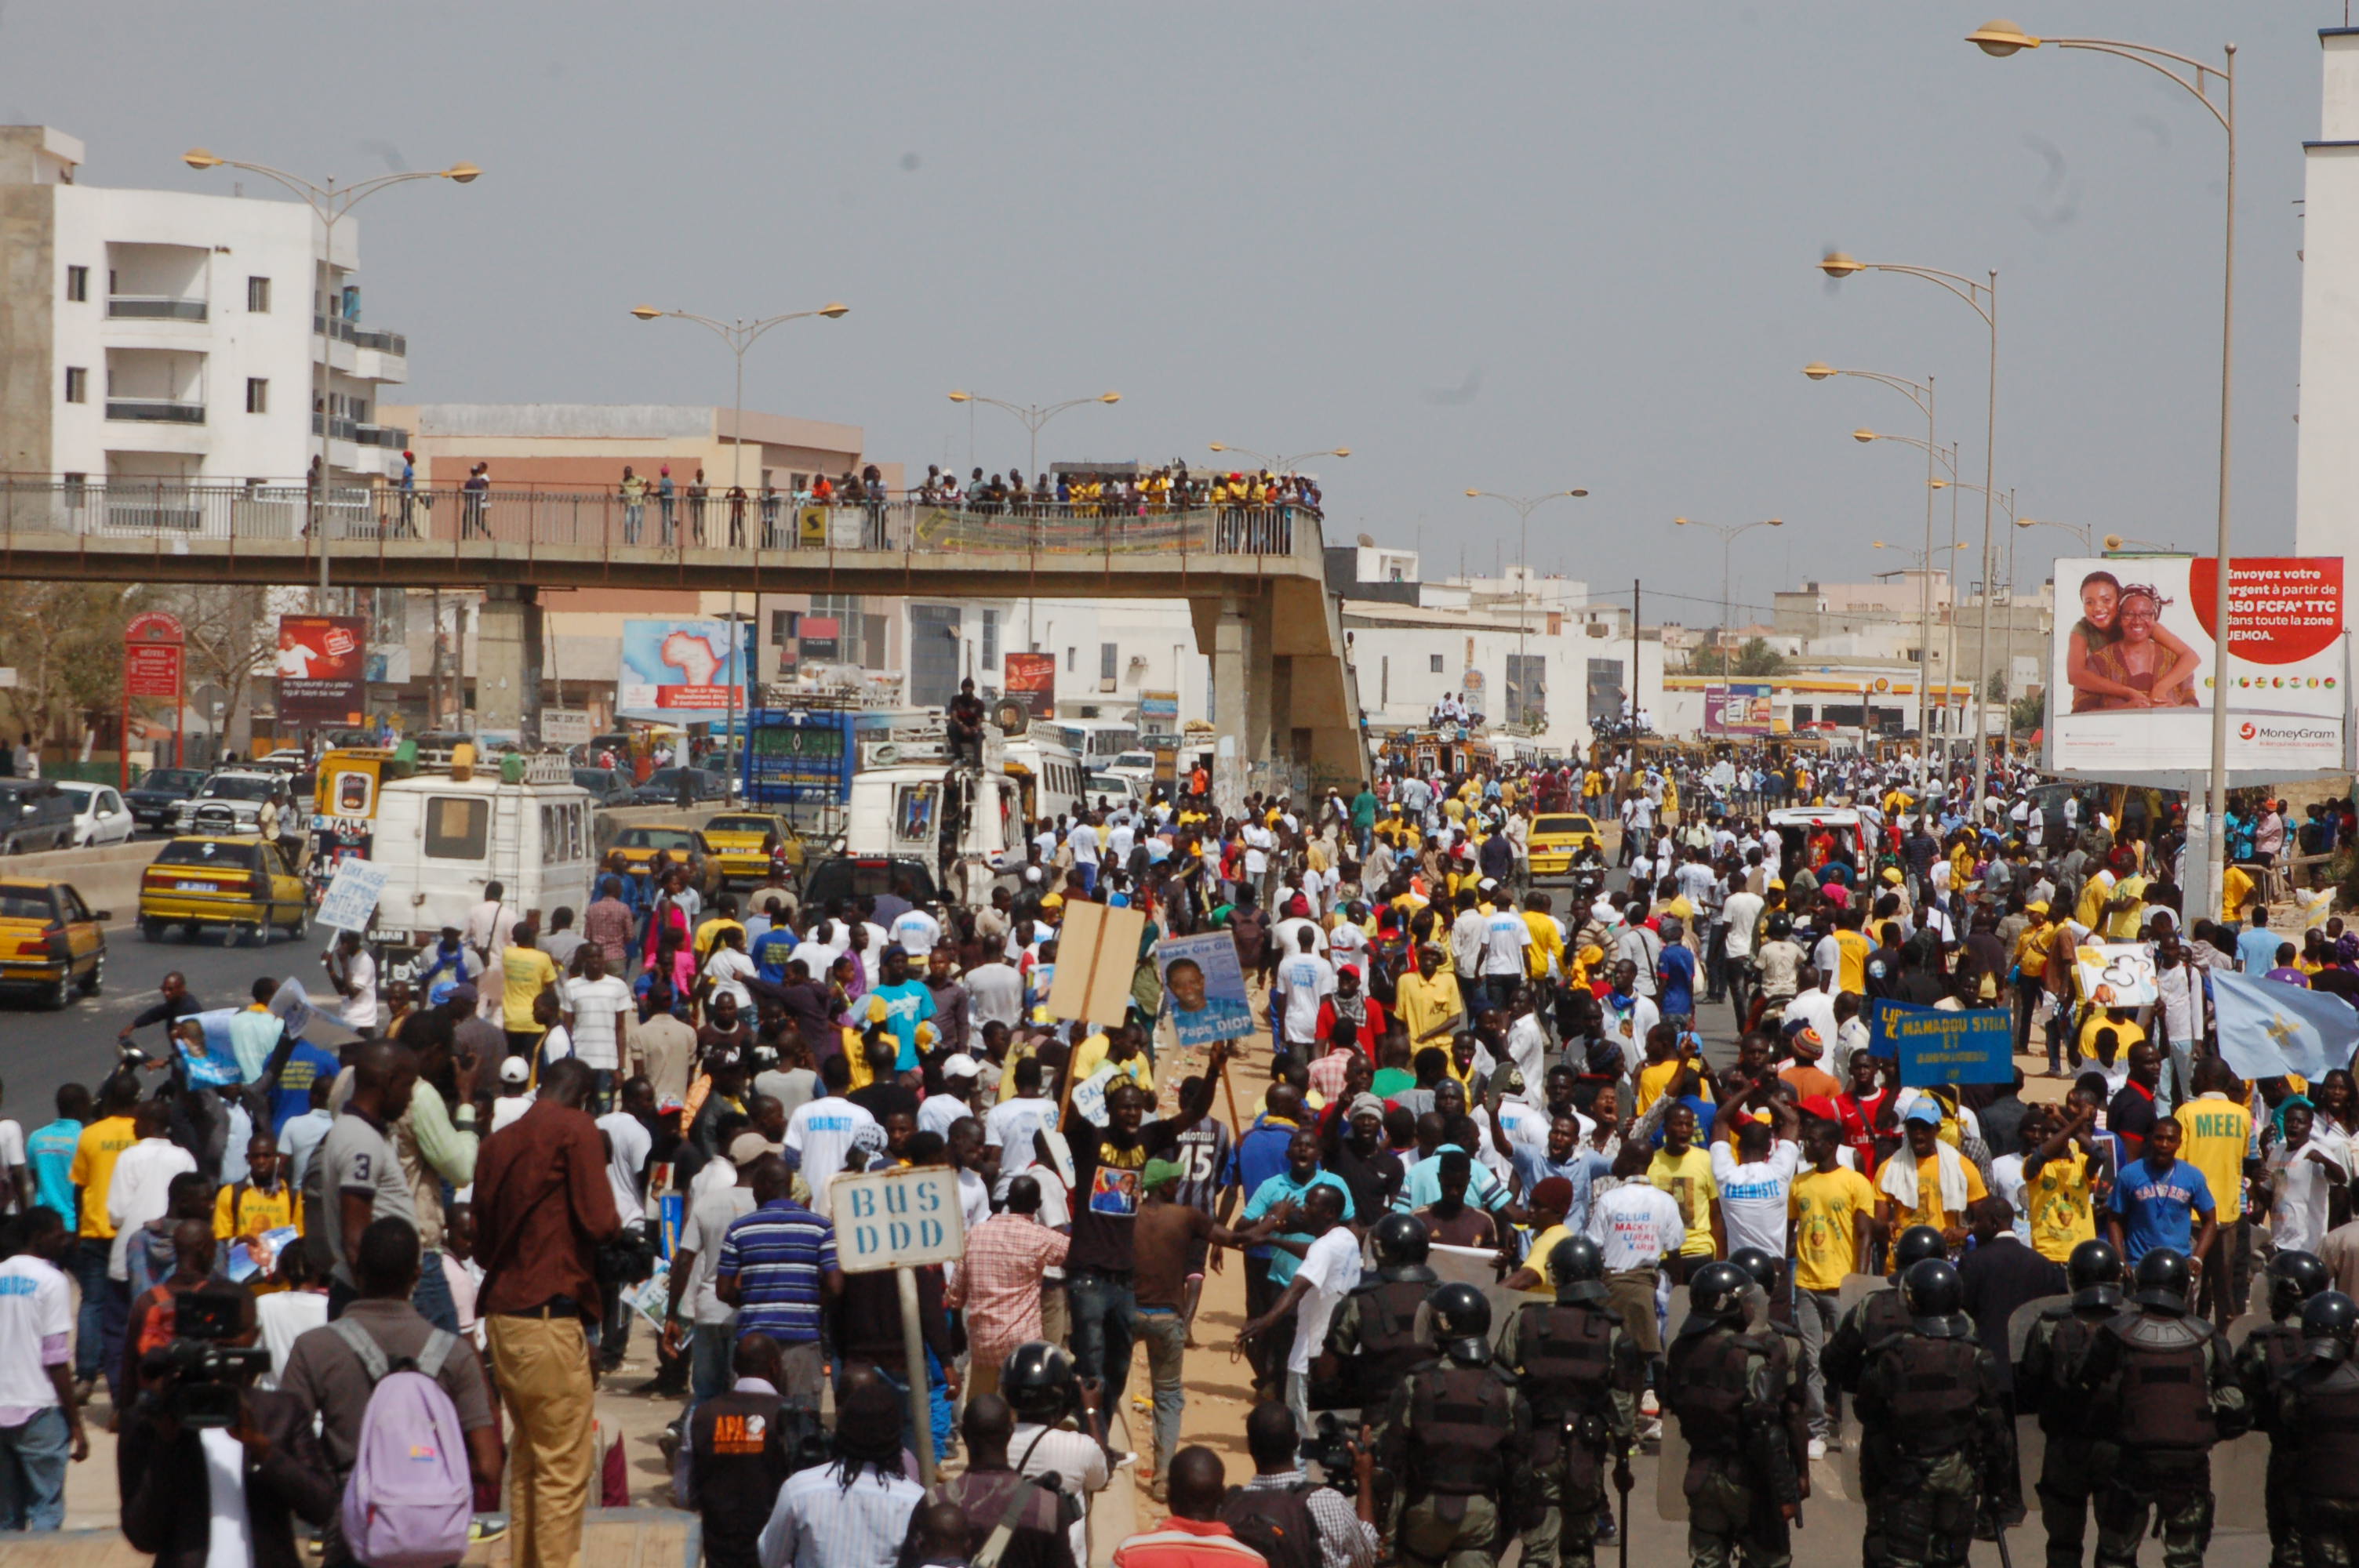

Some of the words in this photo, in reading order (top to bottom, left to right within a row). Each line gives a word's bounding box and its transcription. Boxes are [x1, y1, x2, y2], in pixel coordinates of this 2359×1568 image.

[2227, 570, 2281, 581] Envoyez
[2284, 569, 2321, 579] votre
[2272, 583, 2280, 594] à
[2282, 584, 2318, 596] partir
[2321, 583, 2337, 594] de
[2305, 601, 2336, 612] TTC
[2255, 616, 2288, 625] toute
[2291, 615, 2301, 625] la
[2303, 616, 2334, 625] zone
[2259, 728, 2335, 741] MoneyGram
[1177, 1025, 1212, 1039] Pape
[1216, 1015, 1251, 1032] DIOP
[1903, 1018, 1968, 1036] MAMADOU
[355, 1152, 370, 1181] 3
[1178, 1145, 1214, 1181] 15
[852, 1181, 940, 1218] BUS
[1616, 1213, 1650, 1222] CLUB
[856, 1218, 943, 1254] DDD
[714, 1415, 744, 1441] APA
